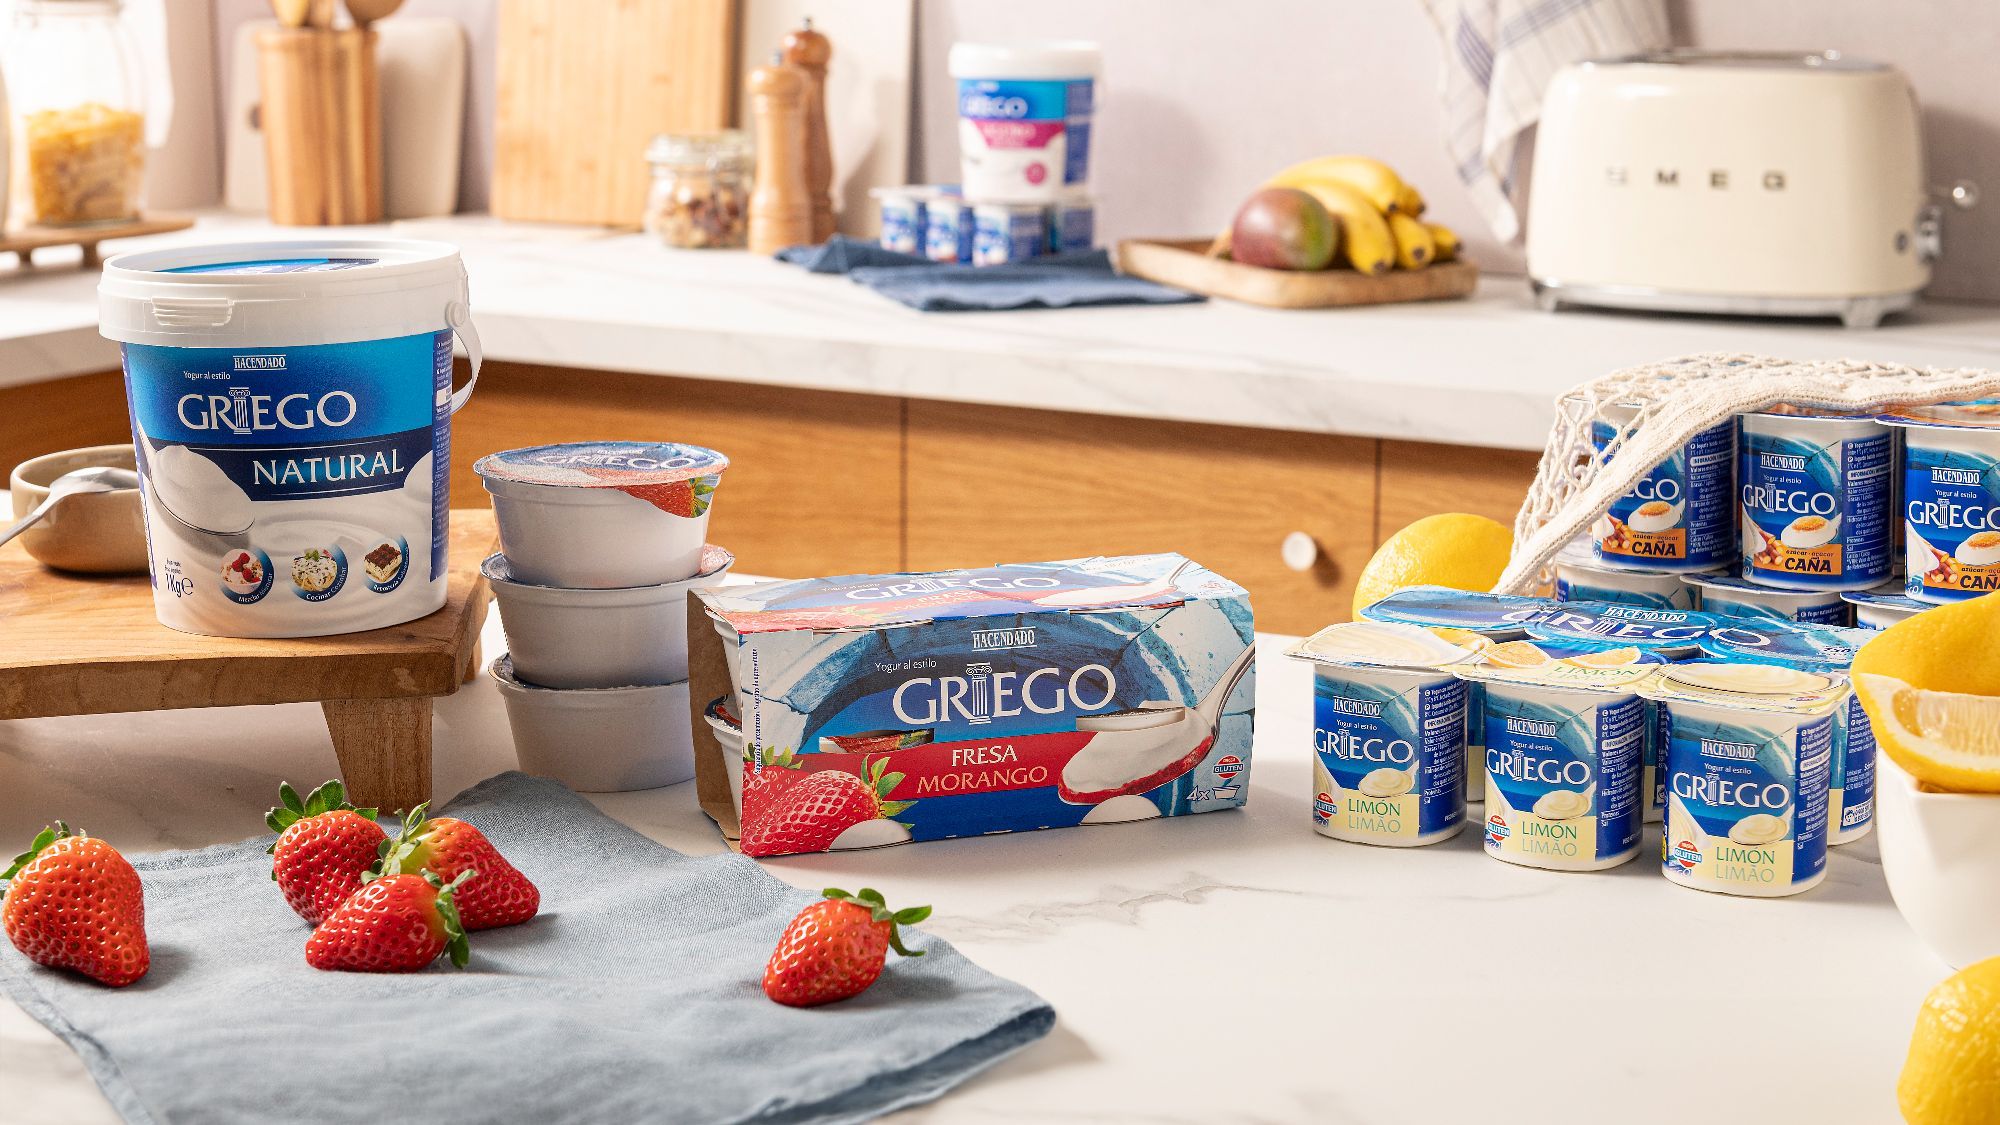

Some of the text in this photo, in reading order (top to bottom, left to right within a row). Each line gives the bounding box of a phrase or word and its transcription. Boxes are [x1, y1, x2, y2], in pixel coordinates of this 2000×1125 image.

[1606, 166, 1786, 192] SMEG
[233, 356, 286, 369] HACENDADO
[183, 370, 231, 381] Yogur al estilo
[177, 386, 358, 434] GRIEGO
[252, 448, 405, 486] NATURAL
[540, 454, 698, 471] GRIEGO
[1761, 454, 1805, 470] HACENDADO
[1763, 475, 1802, 485] Yogur al estilo
[1931, 469, 1980, 485] HACENDADO
[1622, 477, 1680, 501] GO
[1935, 489, 1952, 498] Yogur
[1954, 490, 1959, 498] al
[1742, 483, 1836, 515] GRIEGO
[1631, 540, 1677, 556] CAÑA
[1784, 556, 1832, 573] CAÑA
[845, 577, 1061, 601] GRIEGO
[1959, 573, 2000, 590] CAÑ
[306, 591, 331, 601] Cocinar
[1603, 606, 1687, 622] HACENDADO
[1501, 609, 1771, 646] GRIEGO
[972, 629, 1035, 649] HACENDADO
[875, 658, 937, 673] Yogur al estilo
[892, 662, 1117, 725] GRIEGO
[1333, 697, 1381, 717] HACENDADO
[1336, 719, 1378, 731] Yogur al estilo
[1506, 718, 1556, 737] HACENDADO
[1314, 728, 1414, 764] GRIEGO
[1509, 739, 1552, 751] Yogur al estilo
[1701, 740, 1756, 759] HACENDADO
[950, 744, 1018, 767] FRESA
[1214, 764, 1244, 773] GLUTEN
[1486, 749, 1591, 785] GRIEGO
[1704, 763, 1752, 775] Yogur al estilo
[916, 766, 1049, 794] MORANGO
[1186, 784, 1211, 801] 4x
[1673, 772, 1790, 809] GRIEGO
[1348, 798, 1401, 816] LIMÓN
[1348, 815, 1401, 833] LIMÃO
[1522, 821, 1577, 839] LIMÓN
[1522, 838, 1577, 856] LIMÃO
[1716, 846, 1775, 865] LIMÓN
[1716, 863, 1775, 882] LIMÃO
